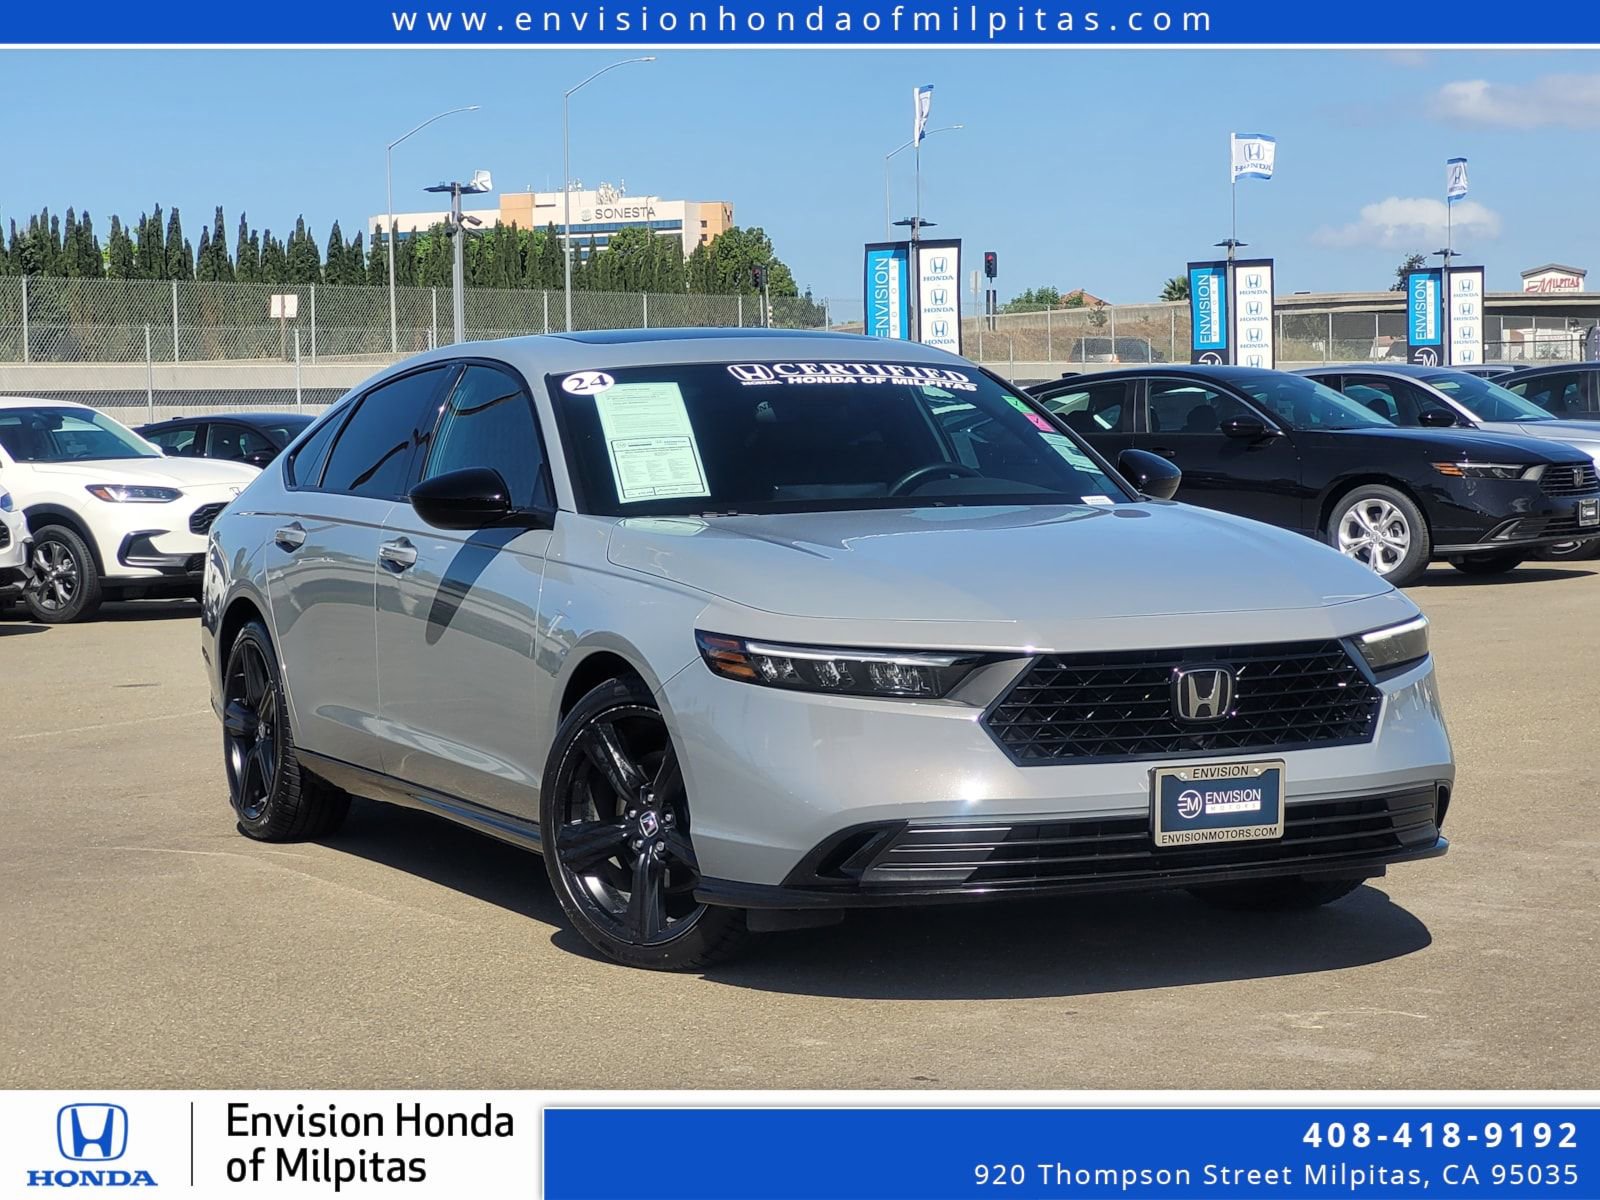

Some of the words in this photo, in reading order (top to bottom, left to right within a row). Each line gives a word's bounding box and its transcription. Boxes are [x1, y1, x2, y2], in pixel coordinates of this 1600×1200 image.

[1235, 163, 1272, 171] HONDA
[595, 207, 656, 220] SONESTA
[875, 258, 889, 337] ENVISION
[1198, 275, 1211, 343] ENVISION
[1415, 280, 1427, 340] ENVISION
[773, 363, 970, 383] CERTIFIED
[568, 374, 609, 391] 24
[788, 376, 857, 384] HONDA
[860, 377, 887, 385] OF
[892, 378, 978, 391] MILPITAS
[1192, 766, 1249, 779] ENVISION
[1205, 789, 1261, 804] ENVISION
[1210, 803, 1257, 812] MOTORS
[1161, 827, 1278, 844] ENVISIONMOTORS.COM
